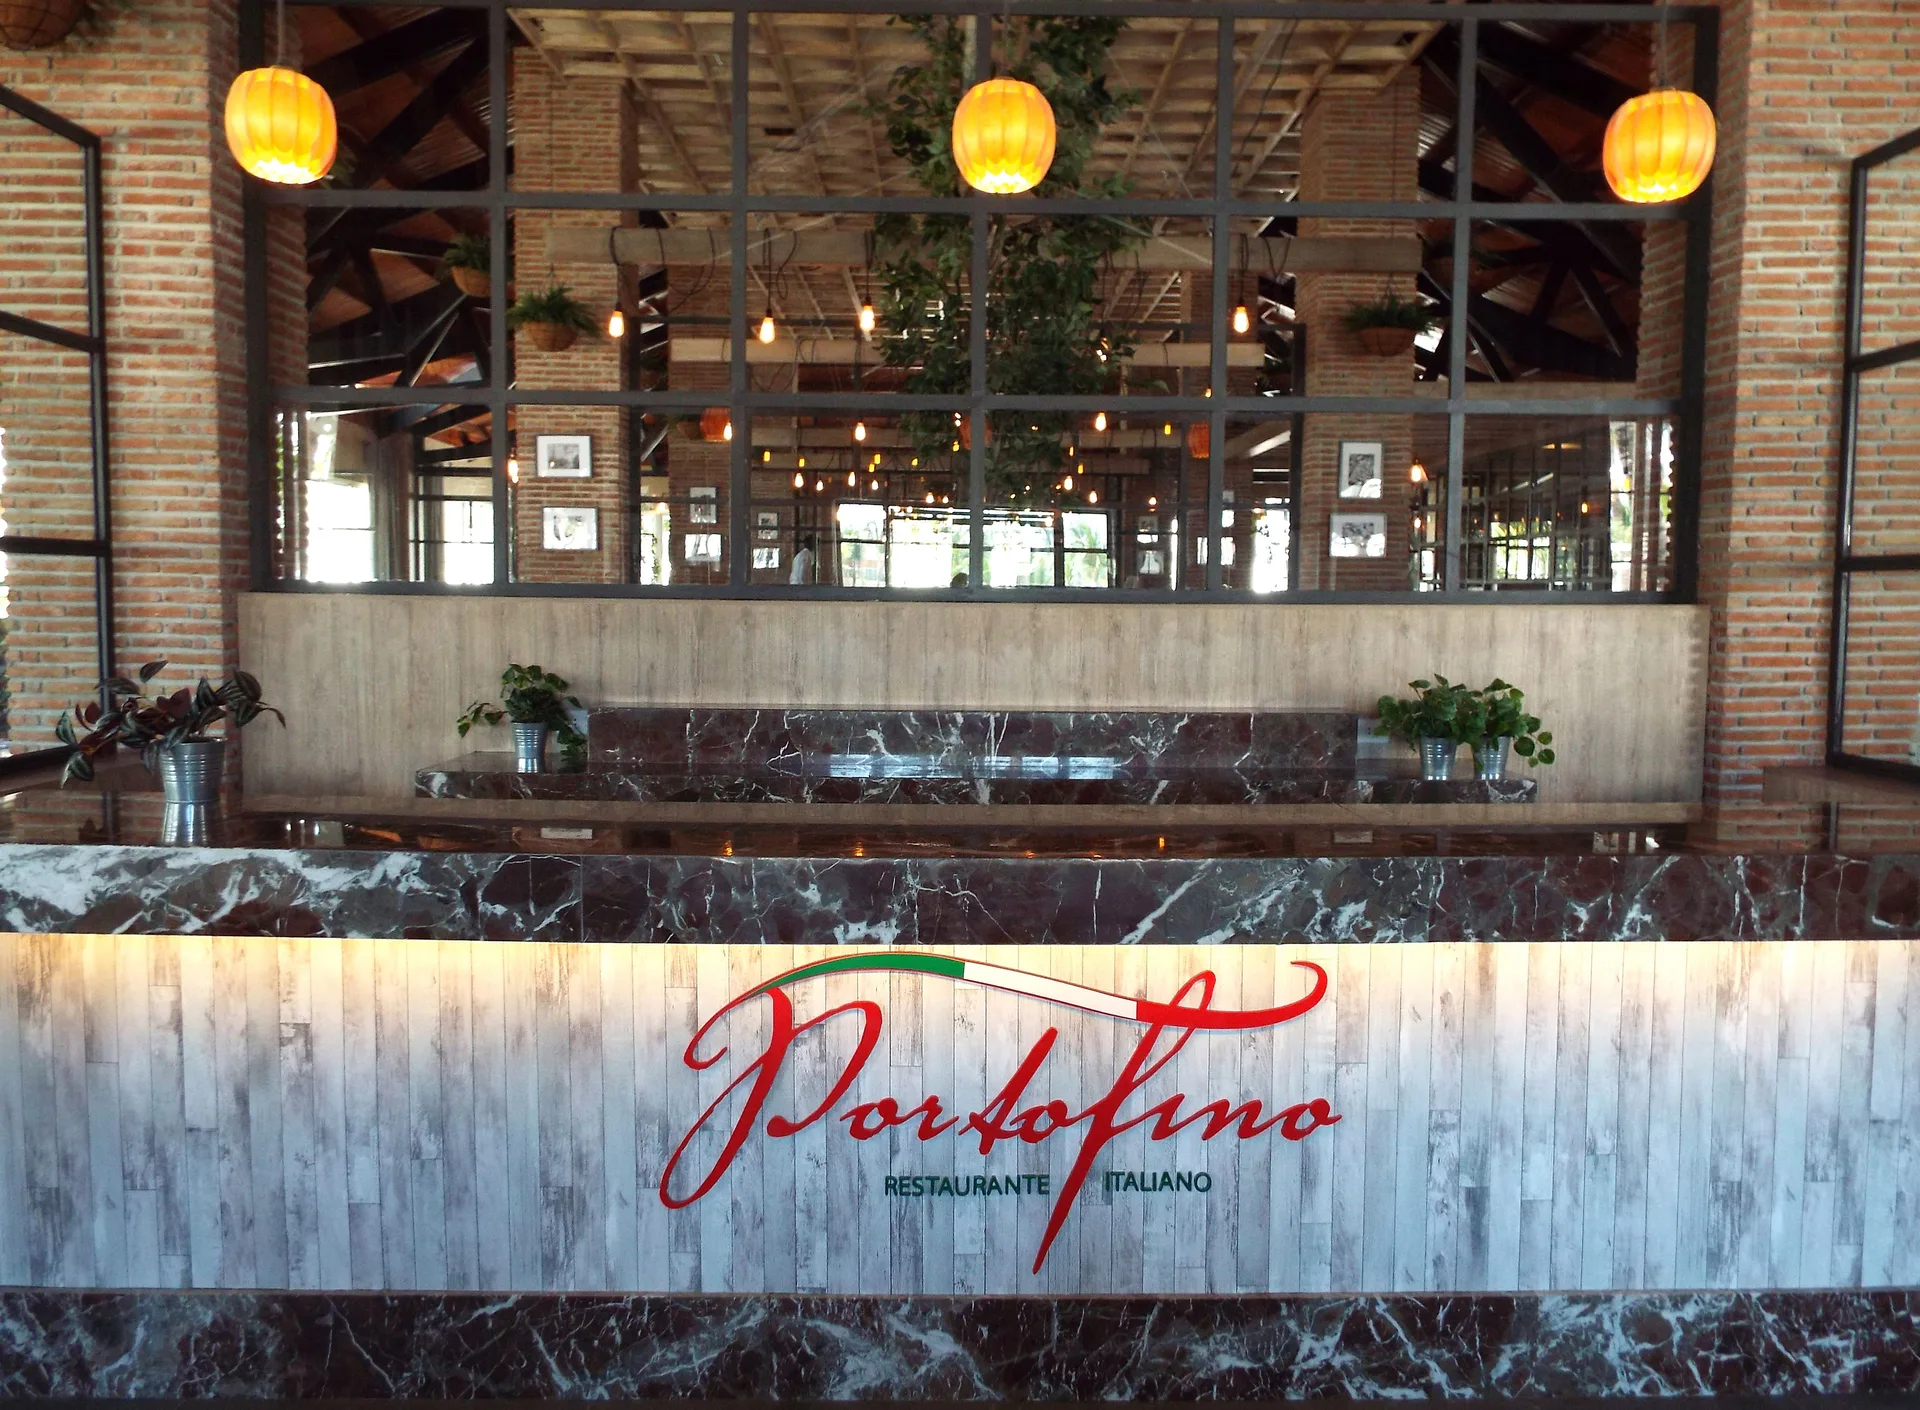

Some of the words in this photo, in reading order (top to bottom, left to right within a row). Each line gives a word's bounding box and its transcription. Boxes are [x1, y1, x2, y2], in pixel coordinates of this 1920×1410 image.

[660, 953, 1342, 1274] Portofino
[884, 1174, 1050, 1197] RESTAURANTE
[1104, 1171, 1213, 1193] ITALIANO
